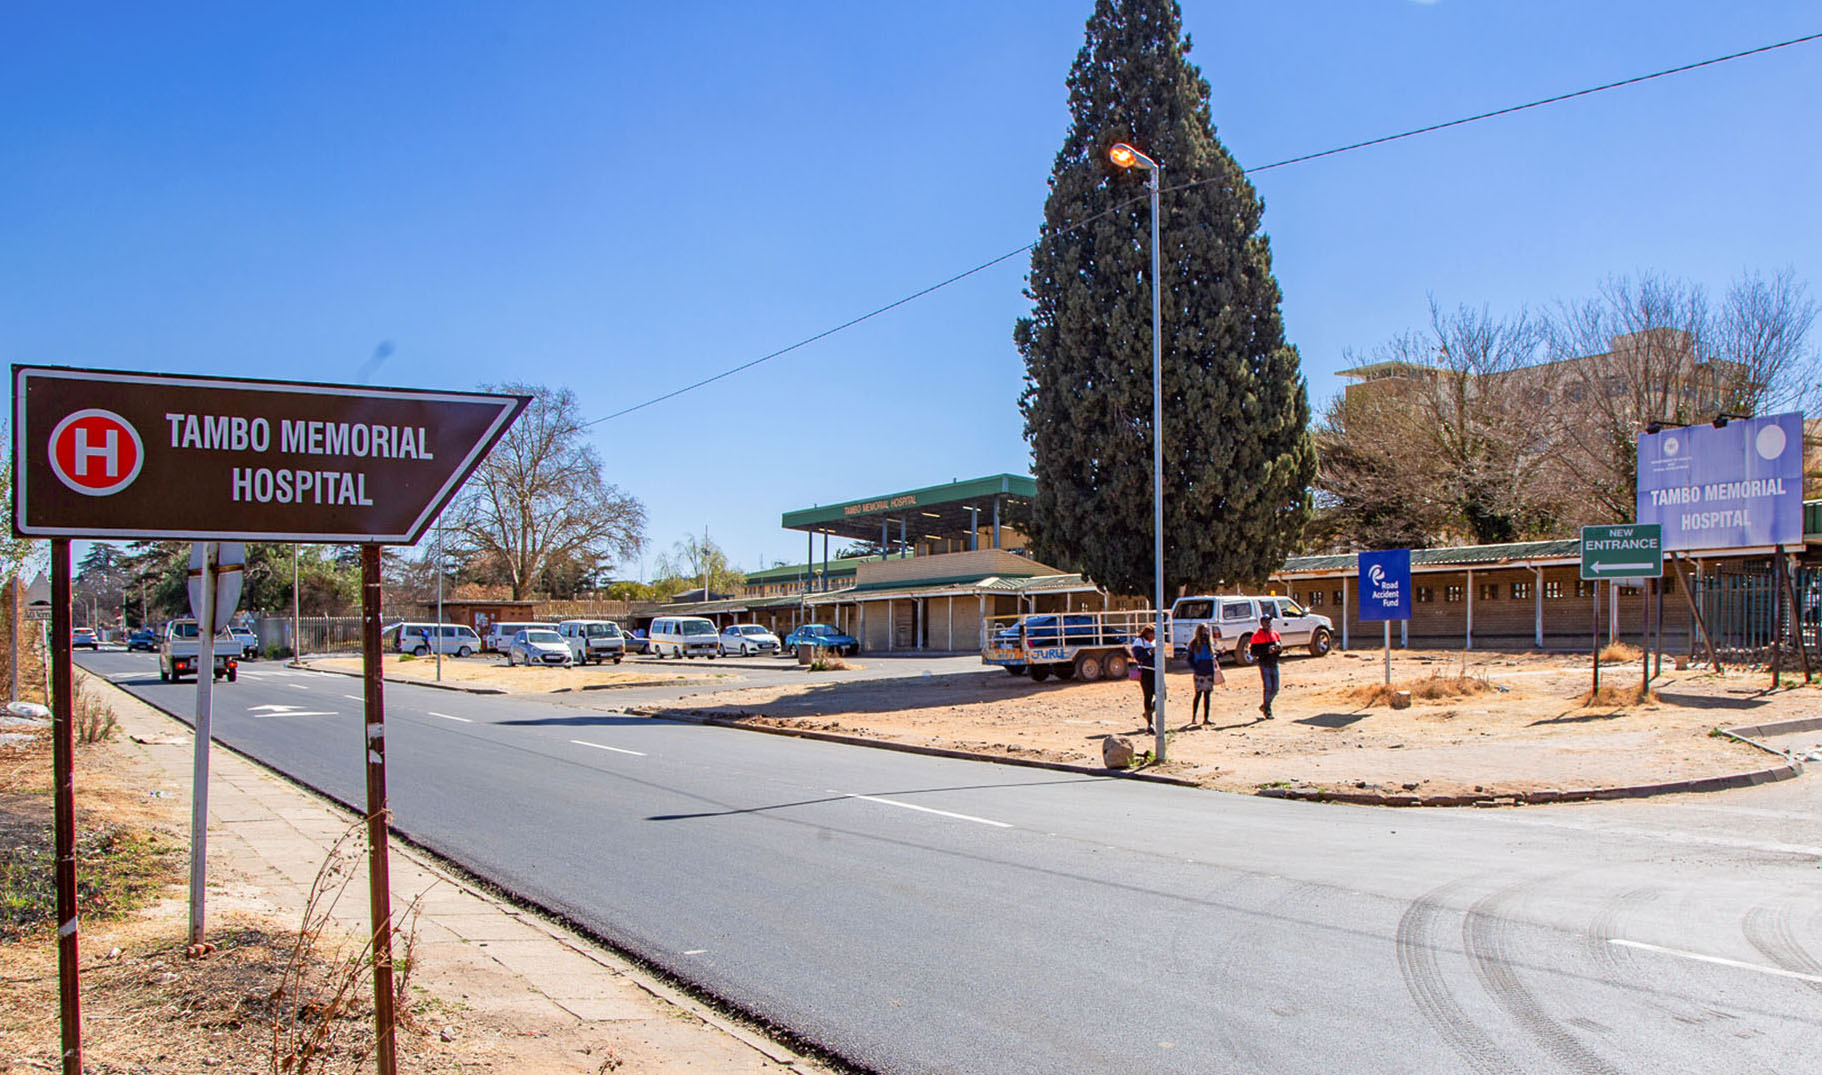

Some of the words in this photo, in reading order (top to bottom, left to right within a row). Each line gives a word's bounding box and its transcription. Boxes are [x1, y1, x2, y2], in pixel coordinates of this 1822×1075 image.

[166, 413, 270, 453] TAMBO
[280, 420, 433, 460] MEMORIAL
[74, 428, 118, 477] H
[232, 467, 373, 506] HOSPITAL
[1651, 486, 1700, 507] TAMBO
[1705, 478, 1785, 501] MEMORIAL
[1681, 510, 1751, 531] HOSPITAL
[1609, 529, 1633, 537] NEW
[1586, 538, 1658, 550] ENTRANCE
[1381, 581, 1398, 589] Road
[1372, 590, 1399, 599] Accident
[1383, 599, 1398, 607] Fund
